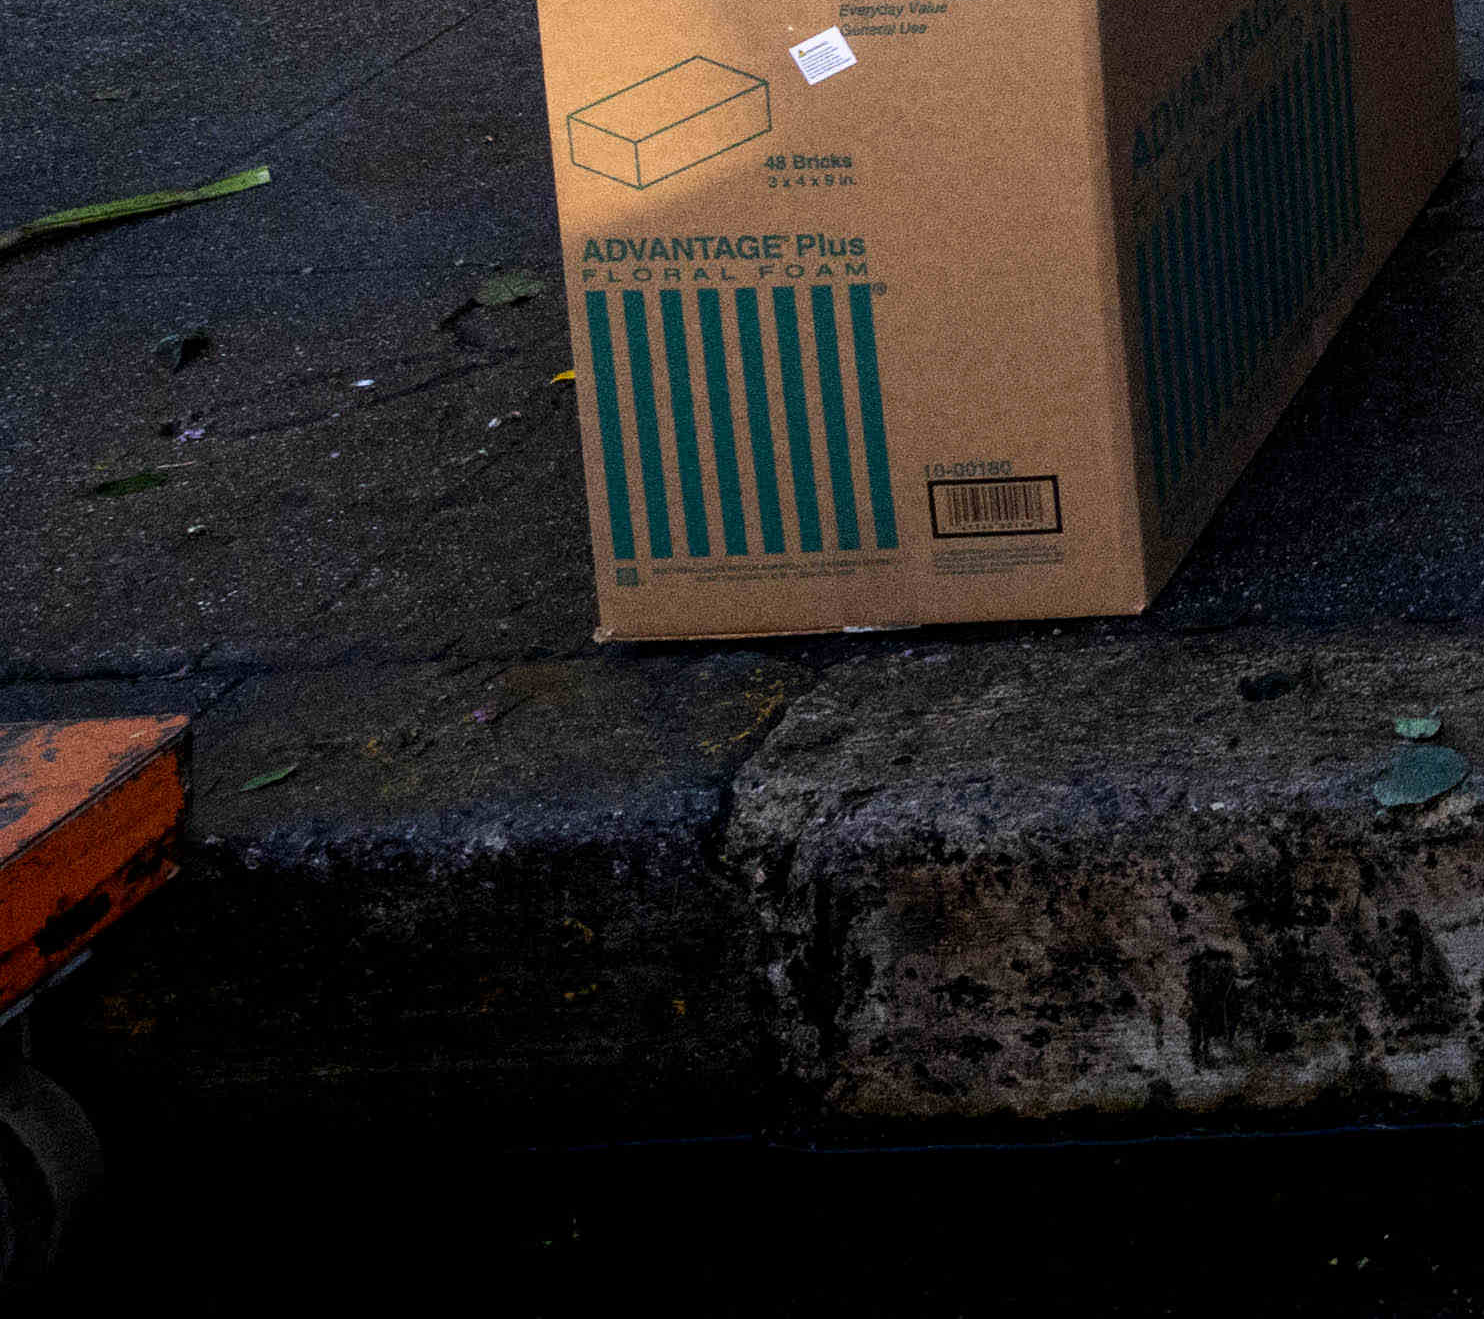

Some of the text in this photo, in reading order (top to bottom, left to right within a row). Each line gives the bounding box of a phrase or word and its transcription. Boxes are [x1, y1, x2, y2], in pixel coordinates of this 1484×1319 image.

[839, 0, 948, 20] Everyday Value
[791, 153, 853, 170] Bricks
[582, 233, 867, 263] ADVANTAGE Plus
[581, 261, 871, 283] FLORAL FOAM
